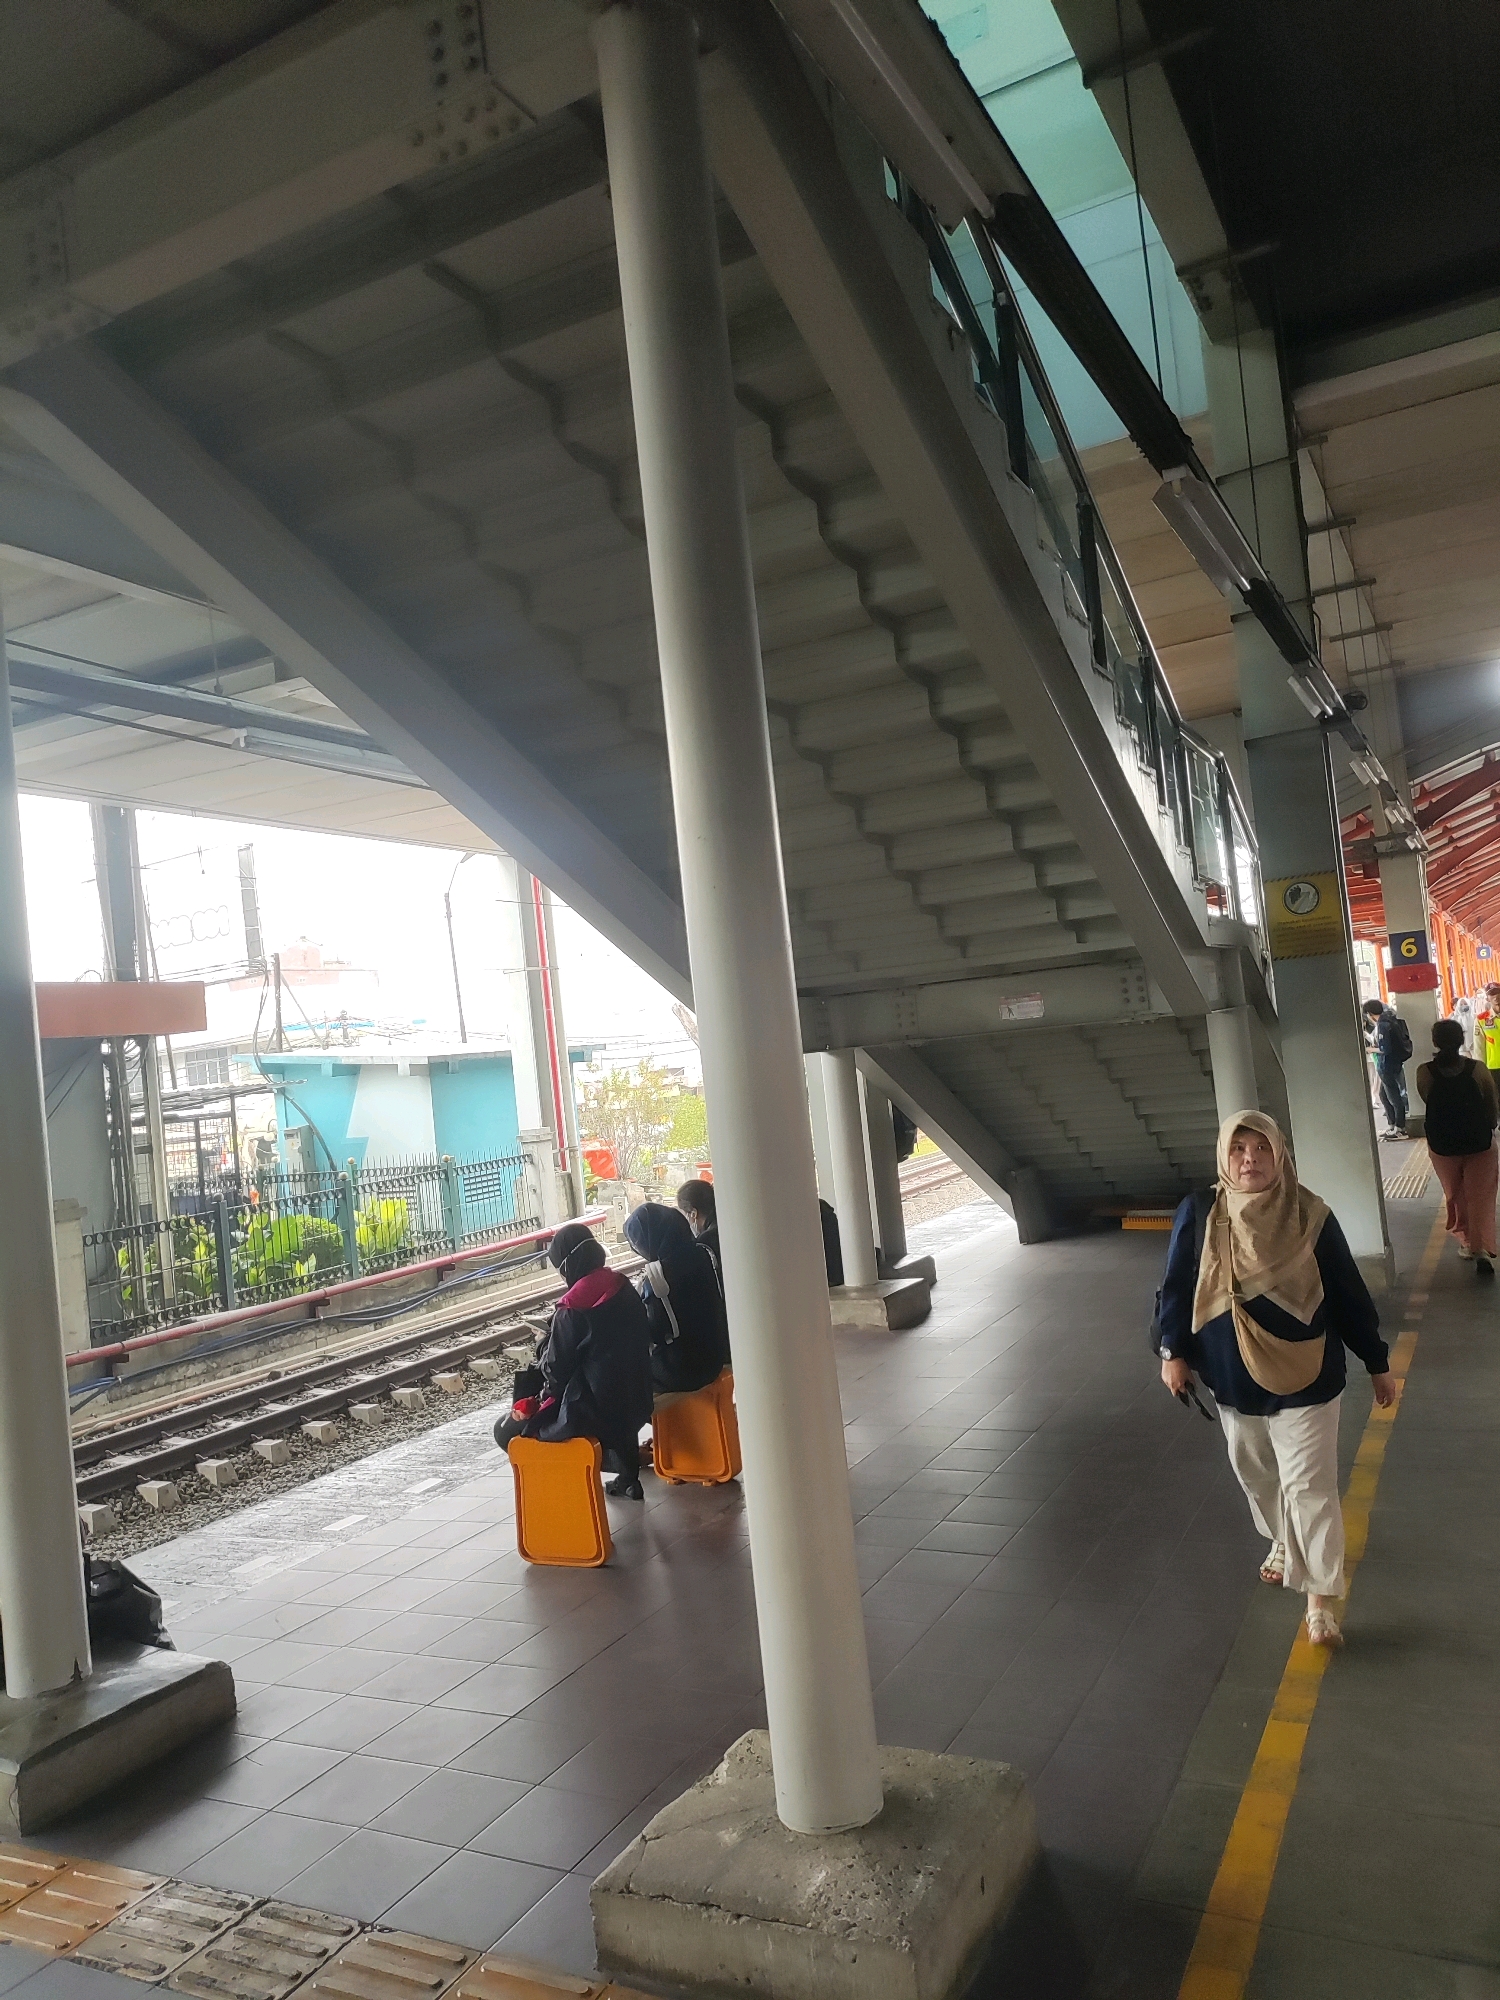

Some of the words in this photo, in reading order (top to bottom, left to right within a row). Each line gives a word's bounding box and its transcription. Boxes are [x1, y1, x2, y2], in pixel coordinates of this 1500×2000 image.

[1400, 937, 1418, 958] 6
[1479, 948, 1487, 957] 6
[617, 1201, 624, 1211] 5
